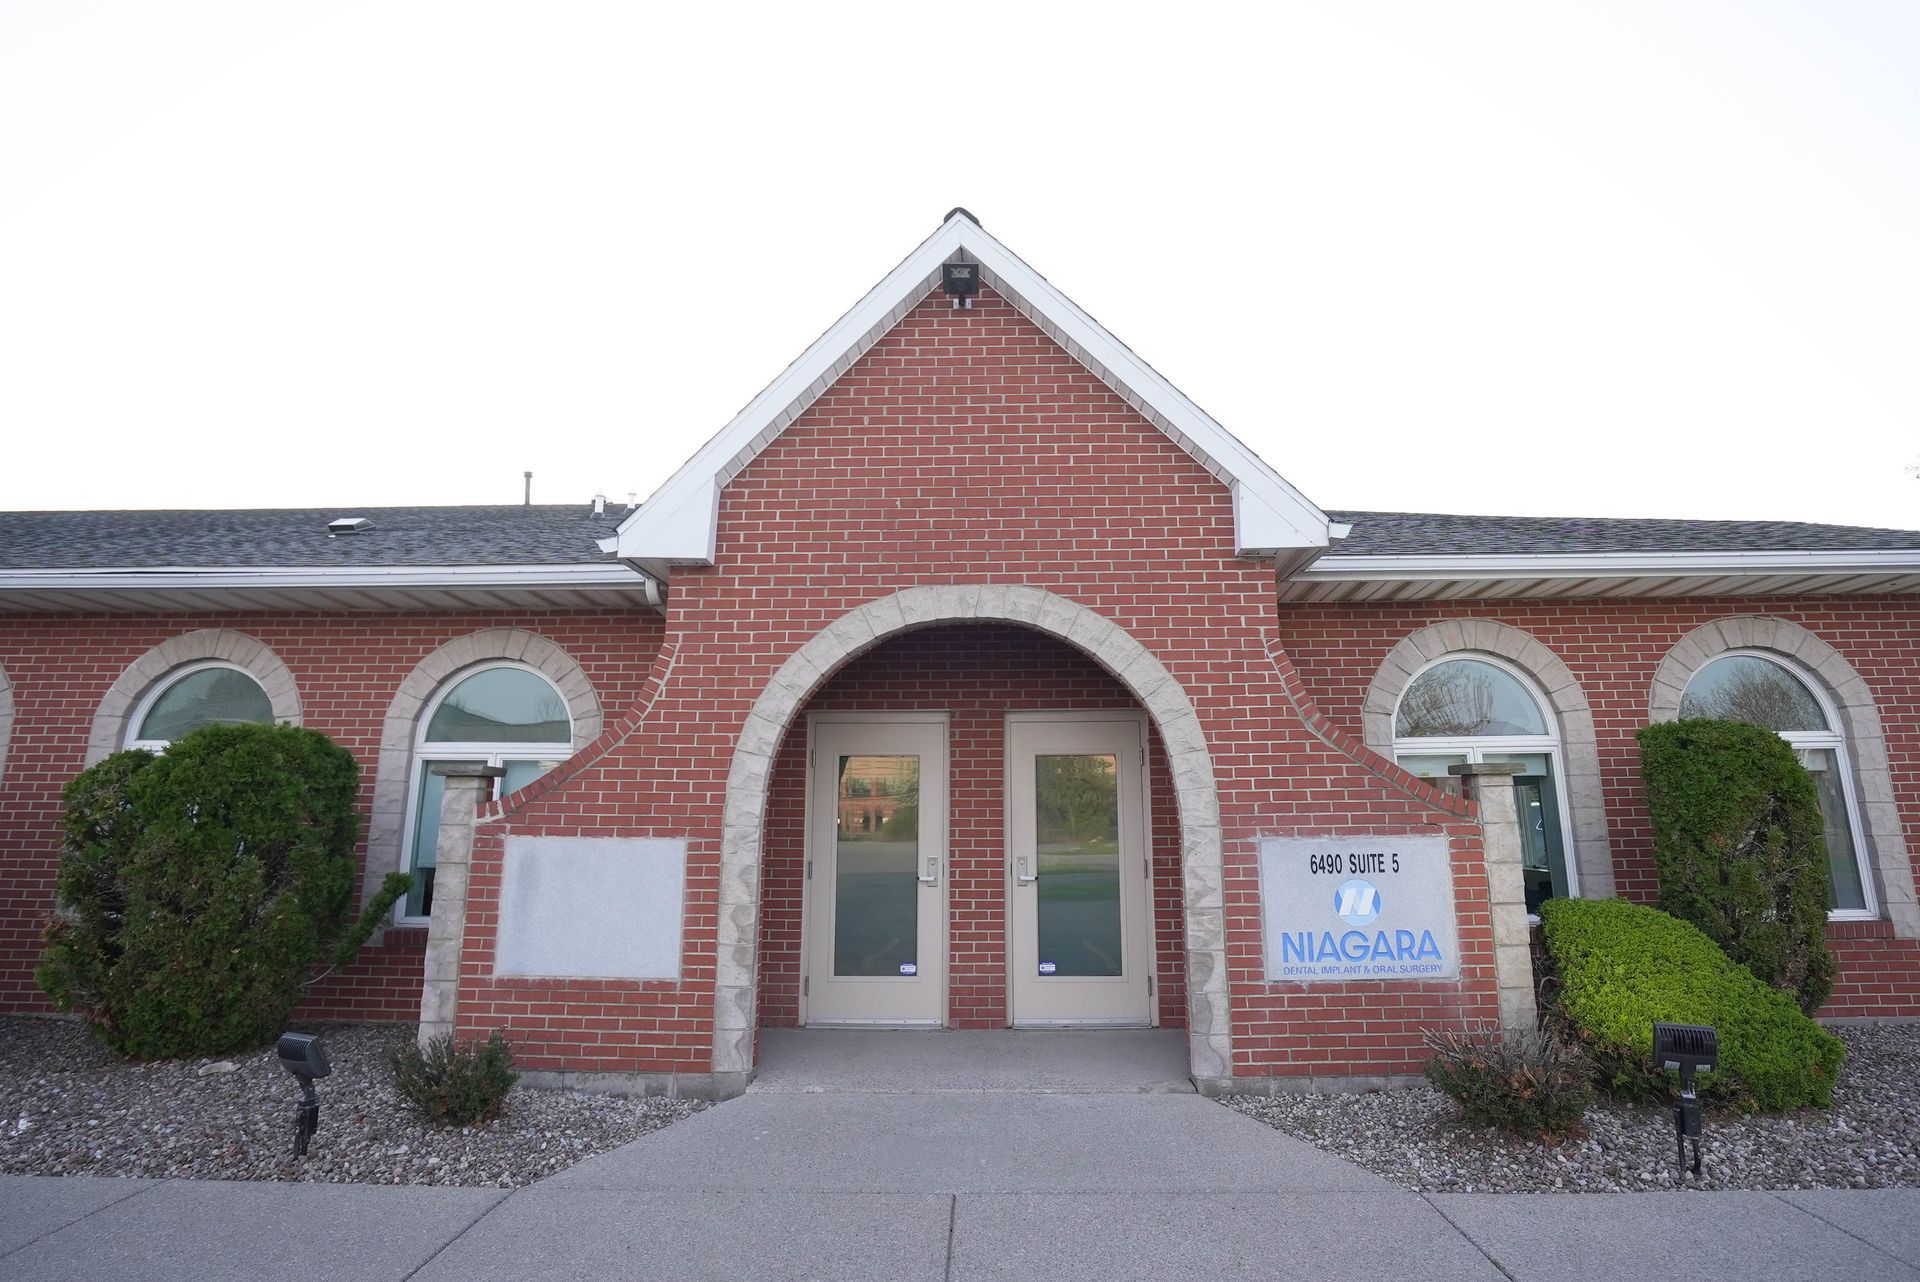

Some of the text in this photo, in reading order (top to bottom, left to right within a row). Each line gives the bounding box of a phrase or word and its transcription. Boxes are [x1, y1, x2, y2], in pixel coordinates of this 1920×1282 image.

[1310, 853, 1400, 875] 6490 SUITE 5
[1281, 929, 1442, 963] NIAGARA
[1283, 964, 1443, 976] DENTAL IMPLANT & ORAL SURGERY
